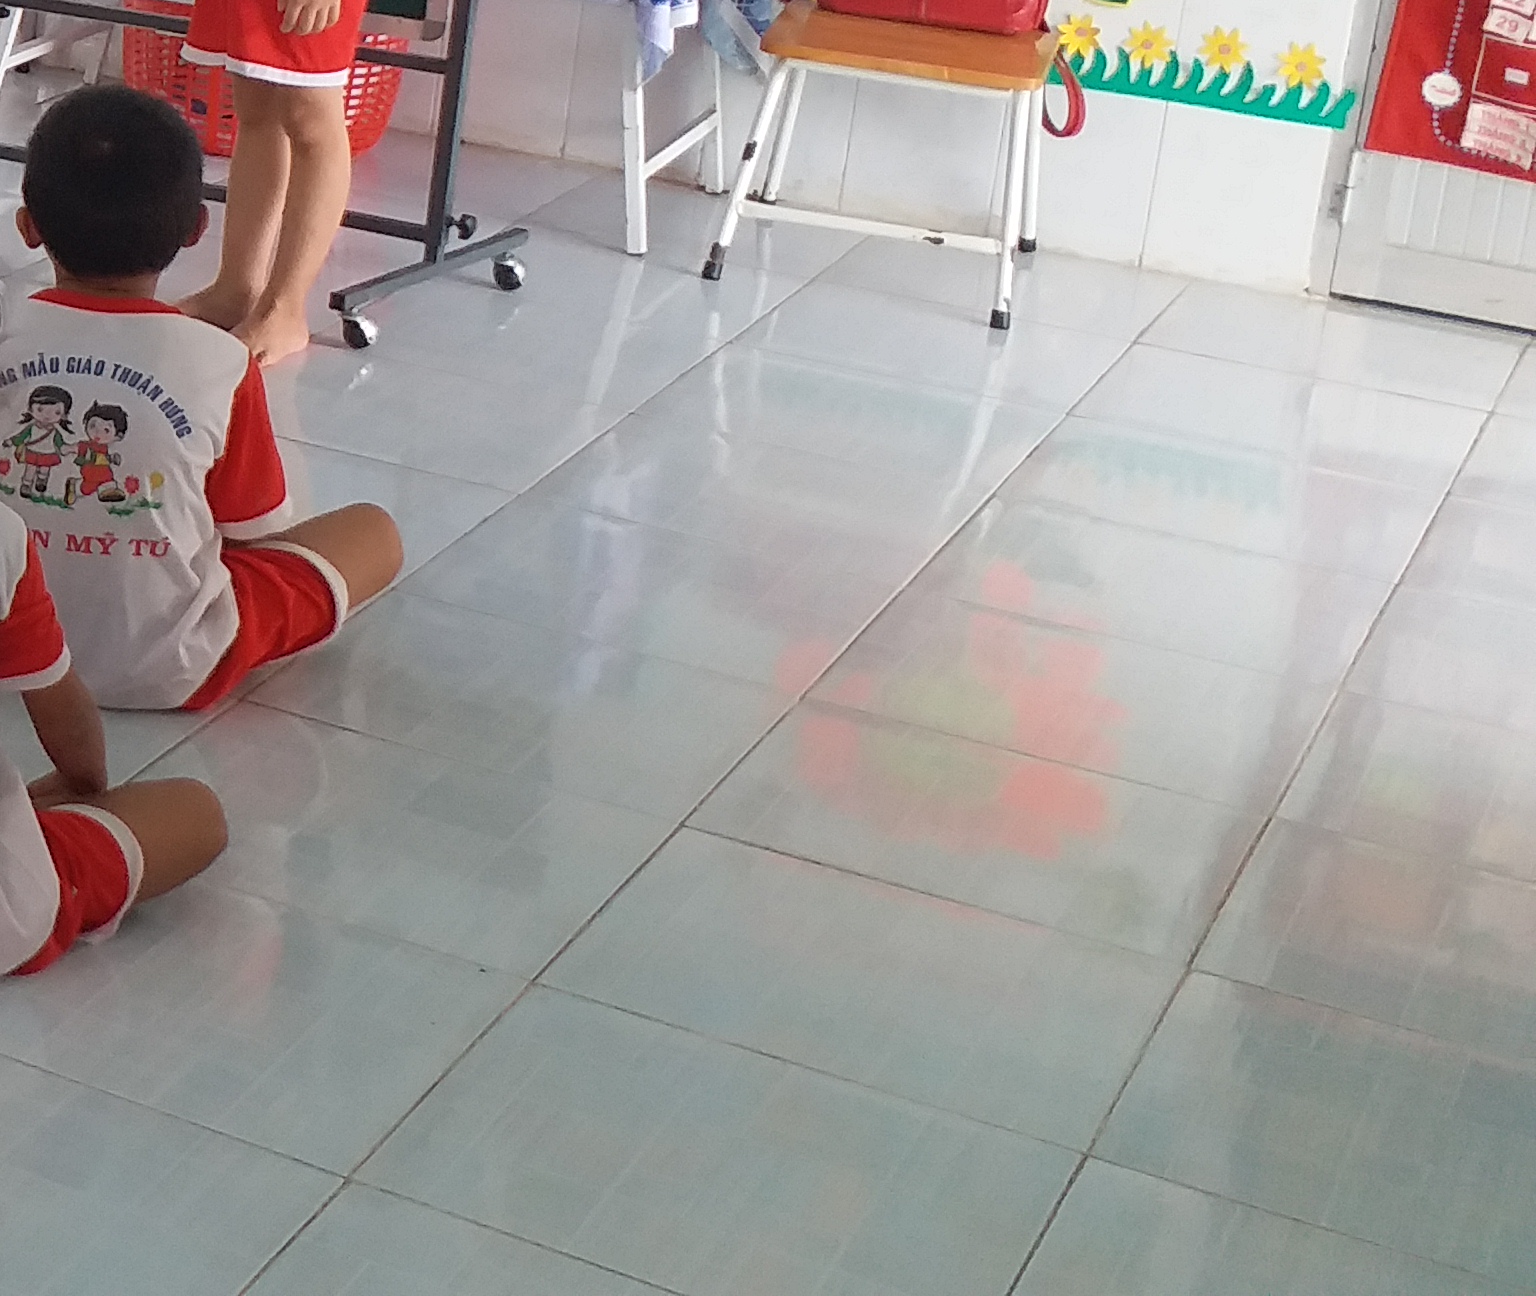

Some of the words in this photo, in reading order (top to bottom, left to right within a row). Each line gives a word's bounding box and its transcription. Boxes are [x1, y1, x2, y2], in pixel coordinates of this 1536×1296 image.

[1495, 15, 1519, 33] 29
[66, 355, 106, 377] GIÁO
[110, 363, 164, 403] THUẬN
[128, 536, 172, 559] TÚ
